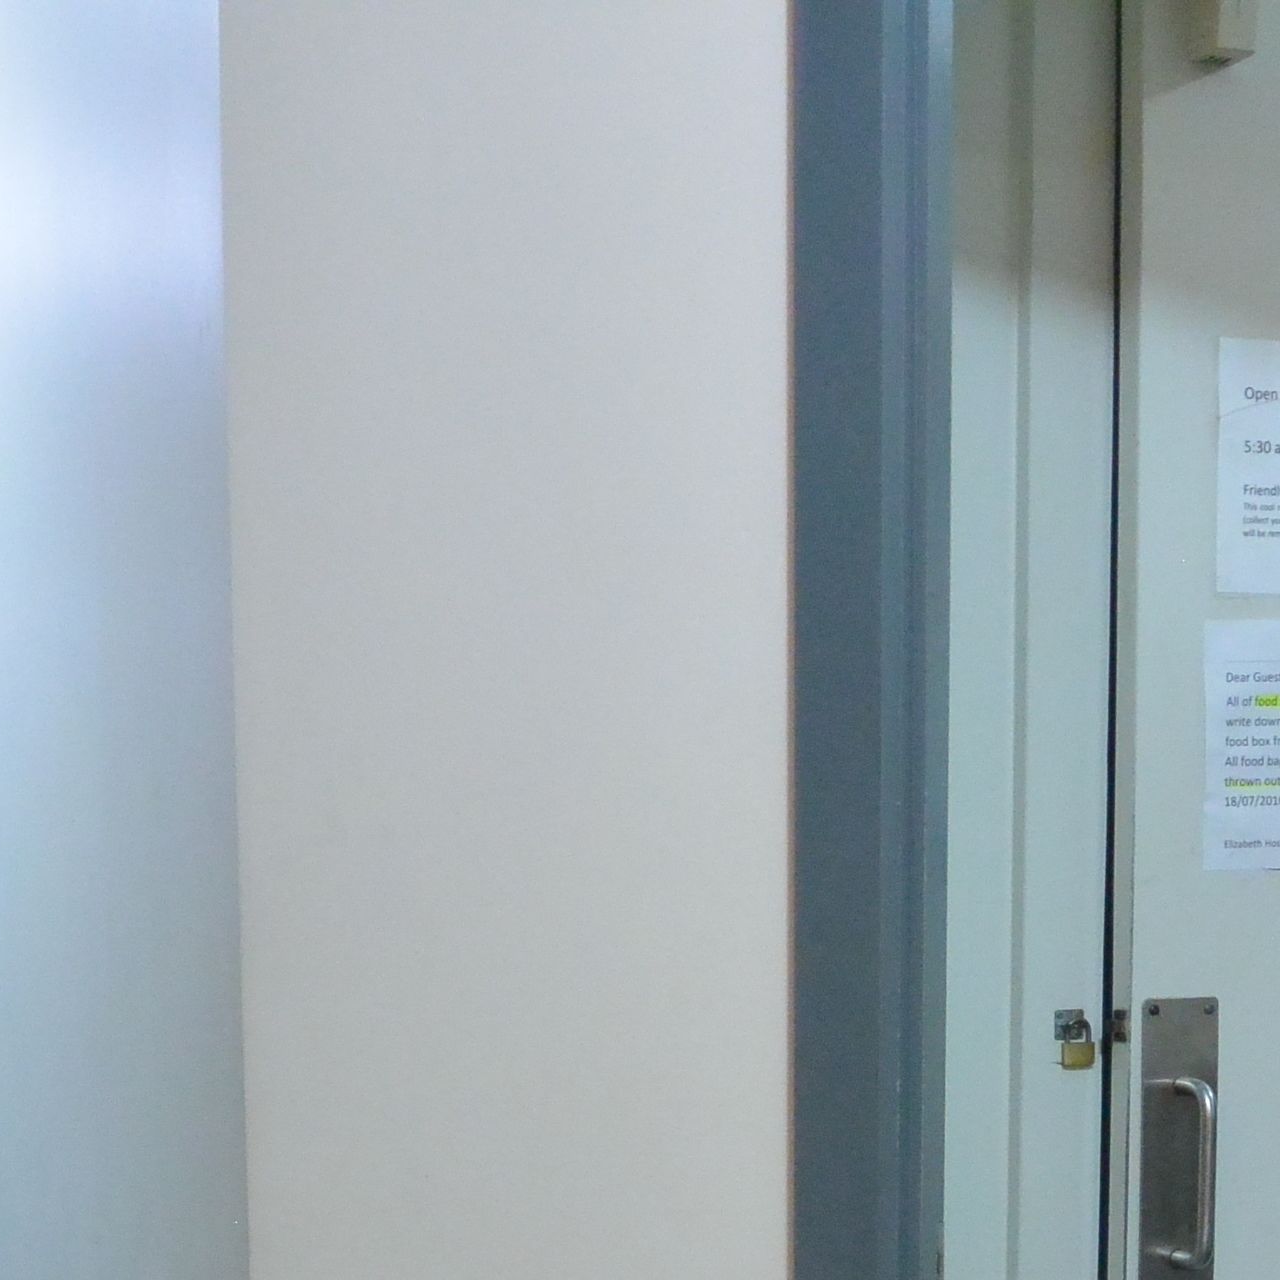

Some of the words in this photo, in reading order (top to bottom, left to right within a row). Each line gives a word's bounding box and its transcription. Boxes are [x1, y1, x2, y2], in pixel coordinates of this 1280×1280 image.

[1244, 386, 1278, 403] Open
[1244, 440, 1272, 454] 5:30
[1226, 672, 1250, 683] Dear
[1226, 697, 1240, 707] All
[1241, 696, 1253, 707] of
[1254, 696, 1279, 707] food
[1226, 717, 1252, 727] write
[1225, 736, 1249, 747] food
[1251, 736, 1270, 747] box
[1225, 757, 1239, 767] All
[1240, 756, 1265, 767] food
[1224, 777, 1262, 788] thrown
[1223, 839, 1263, 849] Elizabeth
